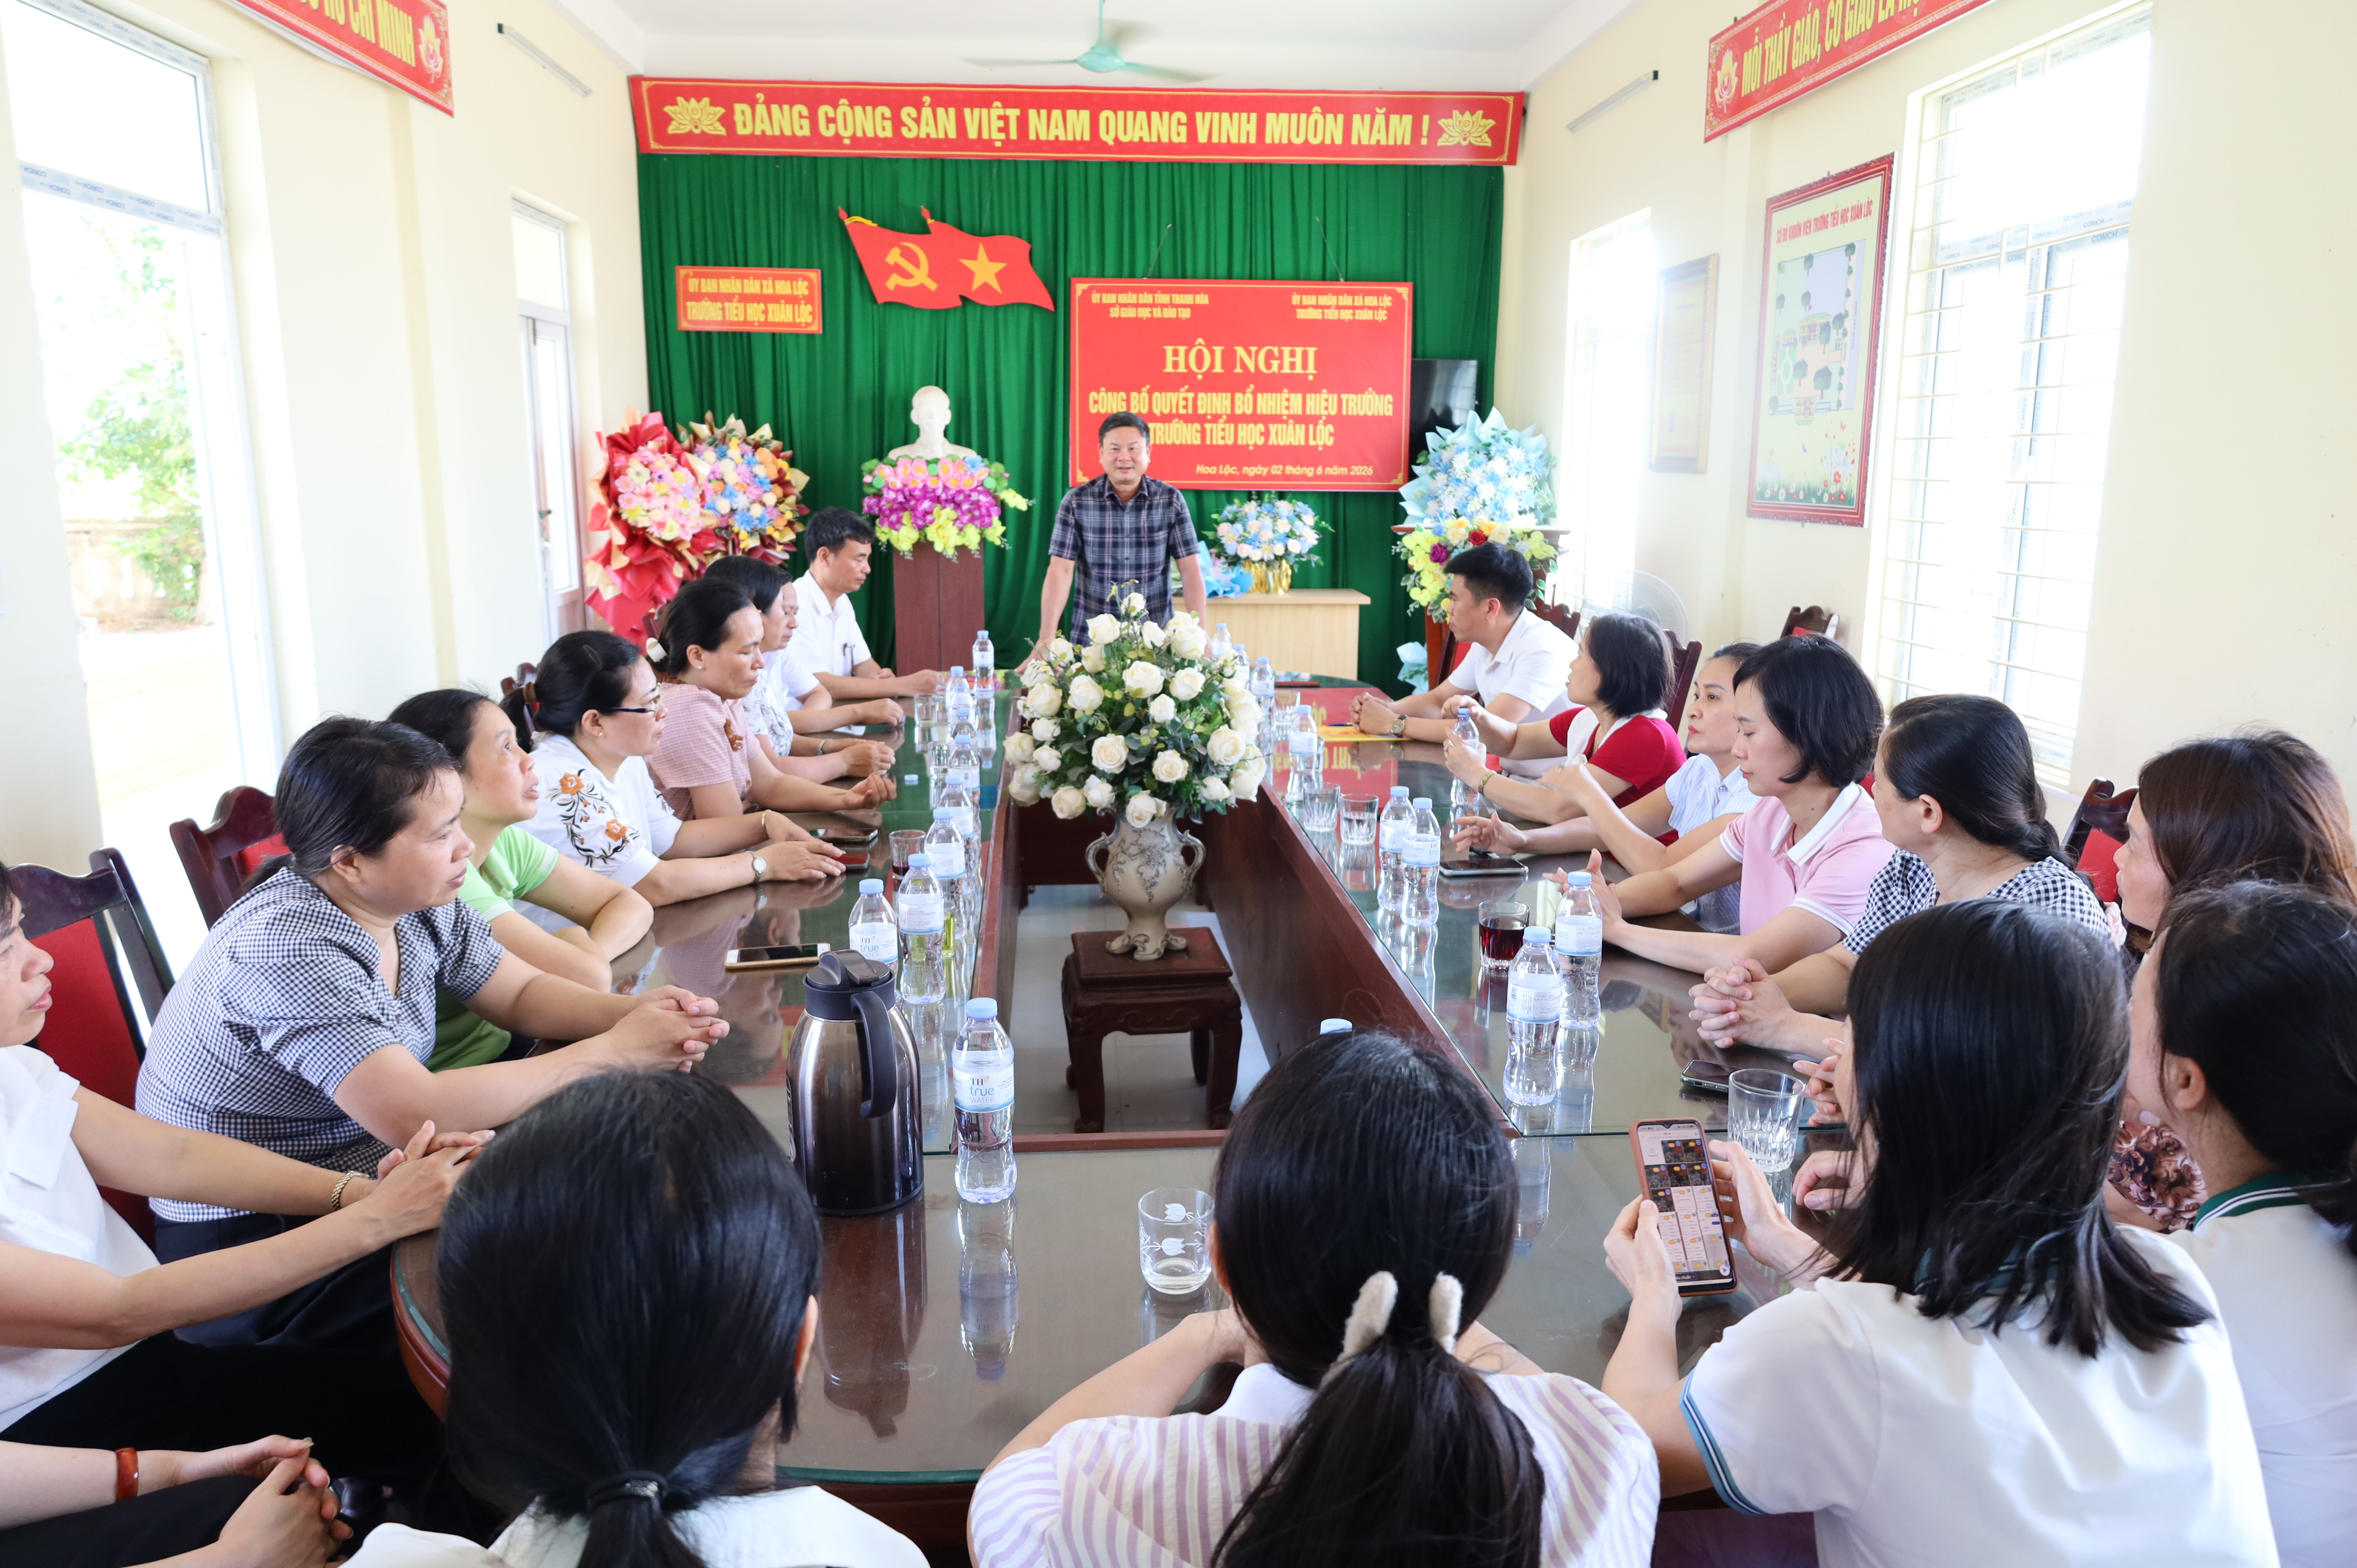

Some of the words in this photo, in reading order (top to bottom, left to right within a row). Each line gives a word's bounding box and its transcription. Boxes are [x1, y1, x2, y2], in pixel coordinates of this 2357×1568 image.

[376, 0, 416, 67] MINH
[1741, 26, 1763, 97] MỖI
[1764, 11, 1792, 85] THẦY
[1792, 2, 1822, 70] GIÁO,
[734, 93, 811, 137] ĐẢNG
[818, 99, 893, 144] CỘNG
[901, 96, 956, 140] SẢN
[963, 101, 1020, 147] VIỆT
[1028, 108, 1091, 141] NAM
[1099, 109, 1188, 143] QUANG
[1195, 112, 1257, 144] VINH
[1265, 106, 1343, 146] MUÔN
[1351, 108, 1413, 146] NĂM
[1421, 115, 1429, 145] !
[1813, 211, 1830, 233] TRƯỜNG
[1831, 204, 1840, 228] TIỂU
[1840, 207, 1850, 228] HỌC
[1850, 201, 1863, 221] XUÂN
[1864, 197, 1873, 221] LỘC
[2091, 231, 2117, 243] CONCH
[2007, 253, 2026, 262] CONC
[688, 271, 699, 292] ỦY
[700, 278, 718, 293] BAN
[719, 276, 742, 293] NHÂN
[743, 276, 761, 294] DÂN
[762, 276, 774, 294] XÃ
[775, 280, 792, 295] HOA
[793, 278, 809, 299] LỘC
[1091, 289, 1101, 304] ỦY
[1101, 293, 1117, 304] BAN
[1118, 291, 1137, 304] NHÂN
[1138, 291, 1153, 304] DÂN
[1154, 290, 1171, 304] TỈNH
[1171, 293, 1194, 304] THANH
[1195, 292, 1210, 304] HÓA
[686, 296, 723, 321] TRƯỜNG
[724, 295, 745, 321] TIỂU
[746, 302, 765, 326] HỌC
[767, 300, 793, 322] XUÂN
[794, 300, 813, 327] LỘC
[1292, 291, 1301, 305] ỦY
[1302, 295, 1317, 305] BAN
[1317, 293, 1338, 305] NHÂN
[1338, 293, 1353, 306] DÂN
[1354, 293, 1363, 306] XÃ
[1364, 295, 1379, 306] HOA
[1379, 294, 1393, 309] LỘC
[1109, 304, 1120, 317] SỞ
[1120, 305, 1137, 318] GIÁO
[1137, 307, 1152, 320] DỤC
[1152, 305, 1162, 318] VÀ
[1162, 305, 1177, 318] ĐÀO
[1178, 308, 1192, 321] TẠO
[1296, 306, 1323, 319] TRƯỜNG
[1324, 305, 1339, 319] TIỂU
[1339, 309, 1354, 322] HỌC
[1354, 308, 1373, 320] XUÂN
[1374, 308, 1388, 322] LỘC
[1163, 338, 1224, 380] HỘI
[1233, 346, 1318, 381] NGHỊ
[1088, 387, 1126, 414] CÔNG
[1130, 384, 1150, 415] BỐ
[1152, 385, 1194, 415] QUYẾT
[1197, 391, 1231, 419] ĐỊNH
[1235, 384, 1254, 415] BỔ
[1257, 390, 1302, 420] NHIỆM
[1305, 391, 1338, 420] HIỆU
[1341, 387, 1393, 417] TRƯỞNG
[1148, 420, 1201, 445] TRƯỜNG
[1205, 415, 1235, 445] TIỂU
[1237, 423, 1264, 450] HỌC
[1268, 420, 1305, 446] XUÂN
[1309, 421, 1334, 450] LỘC
[1196, 465, 1215, 474] Hoa
[1219, 463, 1240, 476] Lộc,
[1242, 466, 1268, 477] ngày
[1270, 465, 1283, 475] 02
[1285, 464, 1314, 478] tháng
[1316, 465, 1323, 475] 6
[1325, 465, 1348, 476] năm
[1350, 466, 1373, 476] 2026
[860, 944, 879, 952] true
[970, 1086, 994, 1097] true
